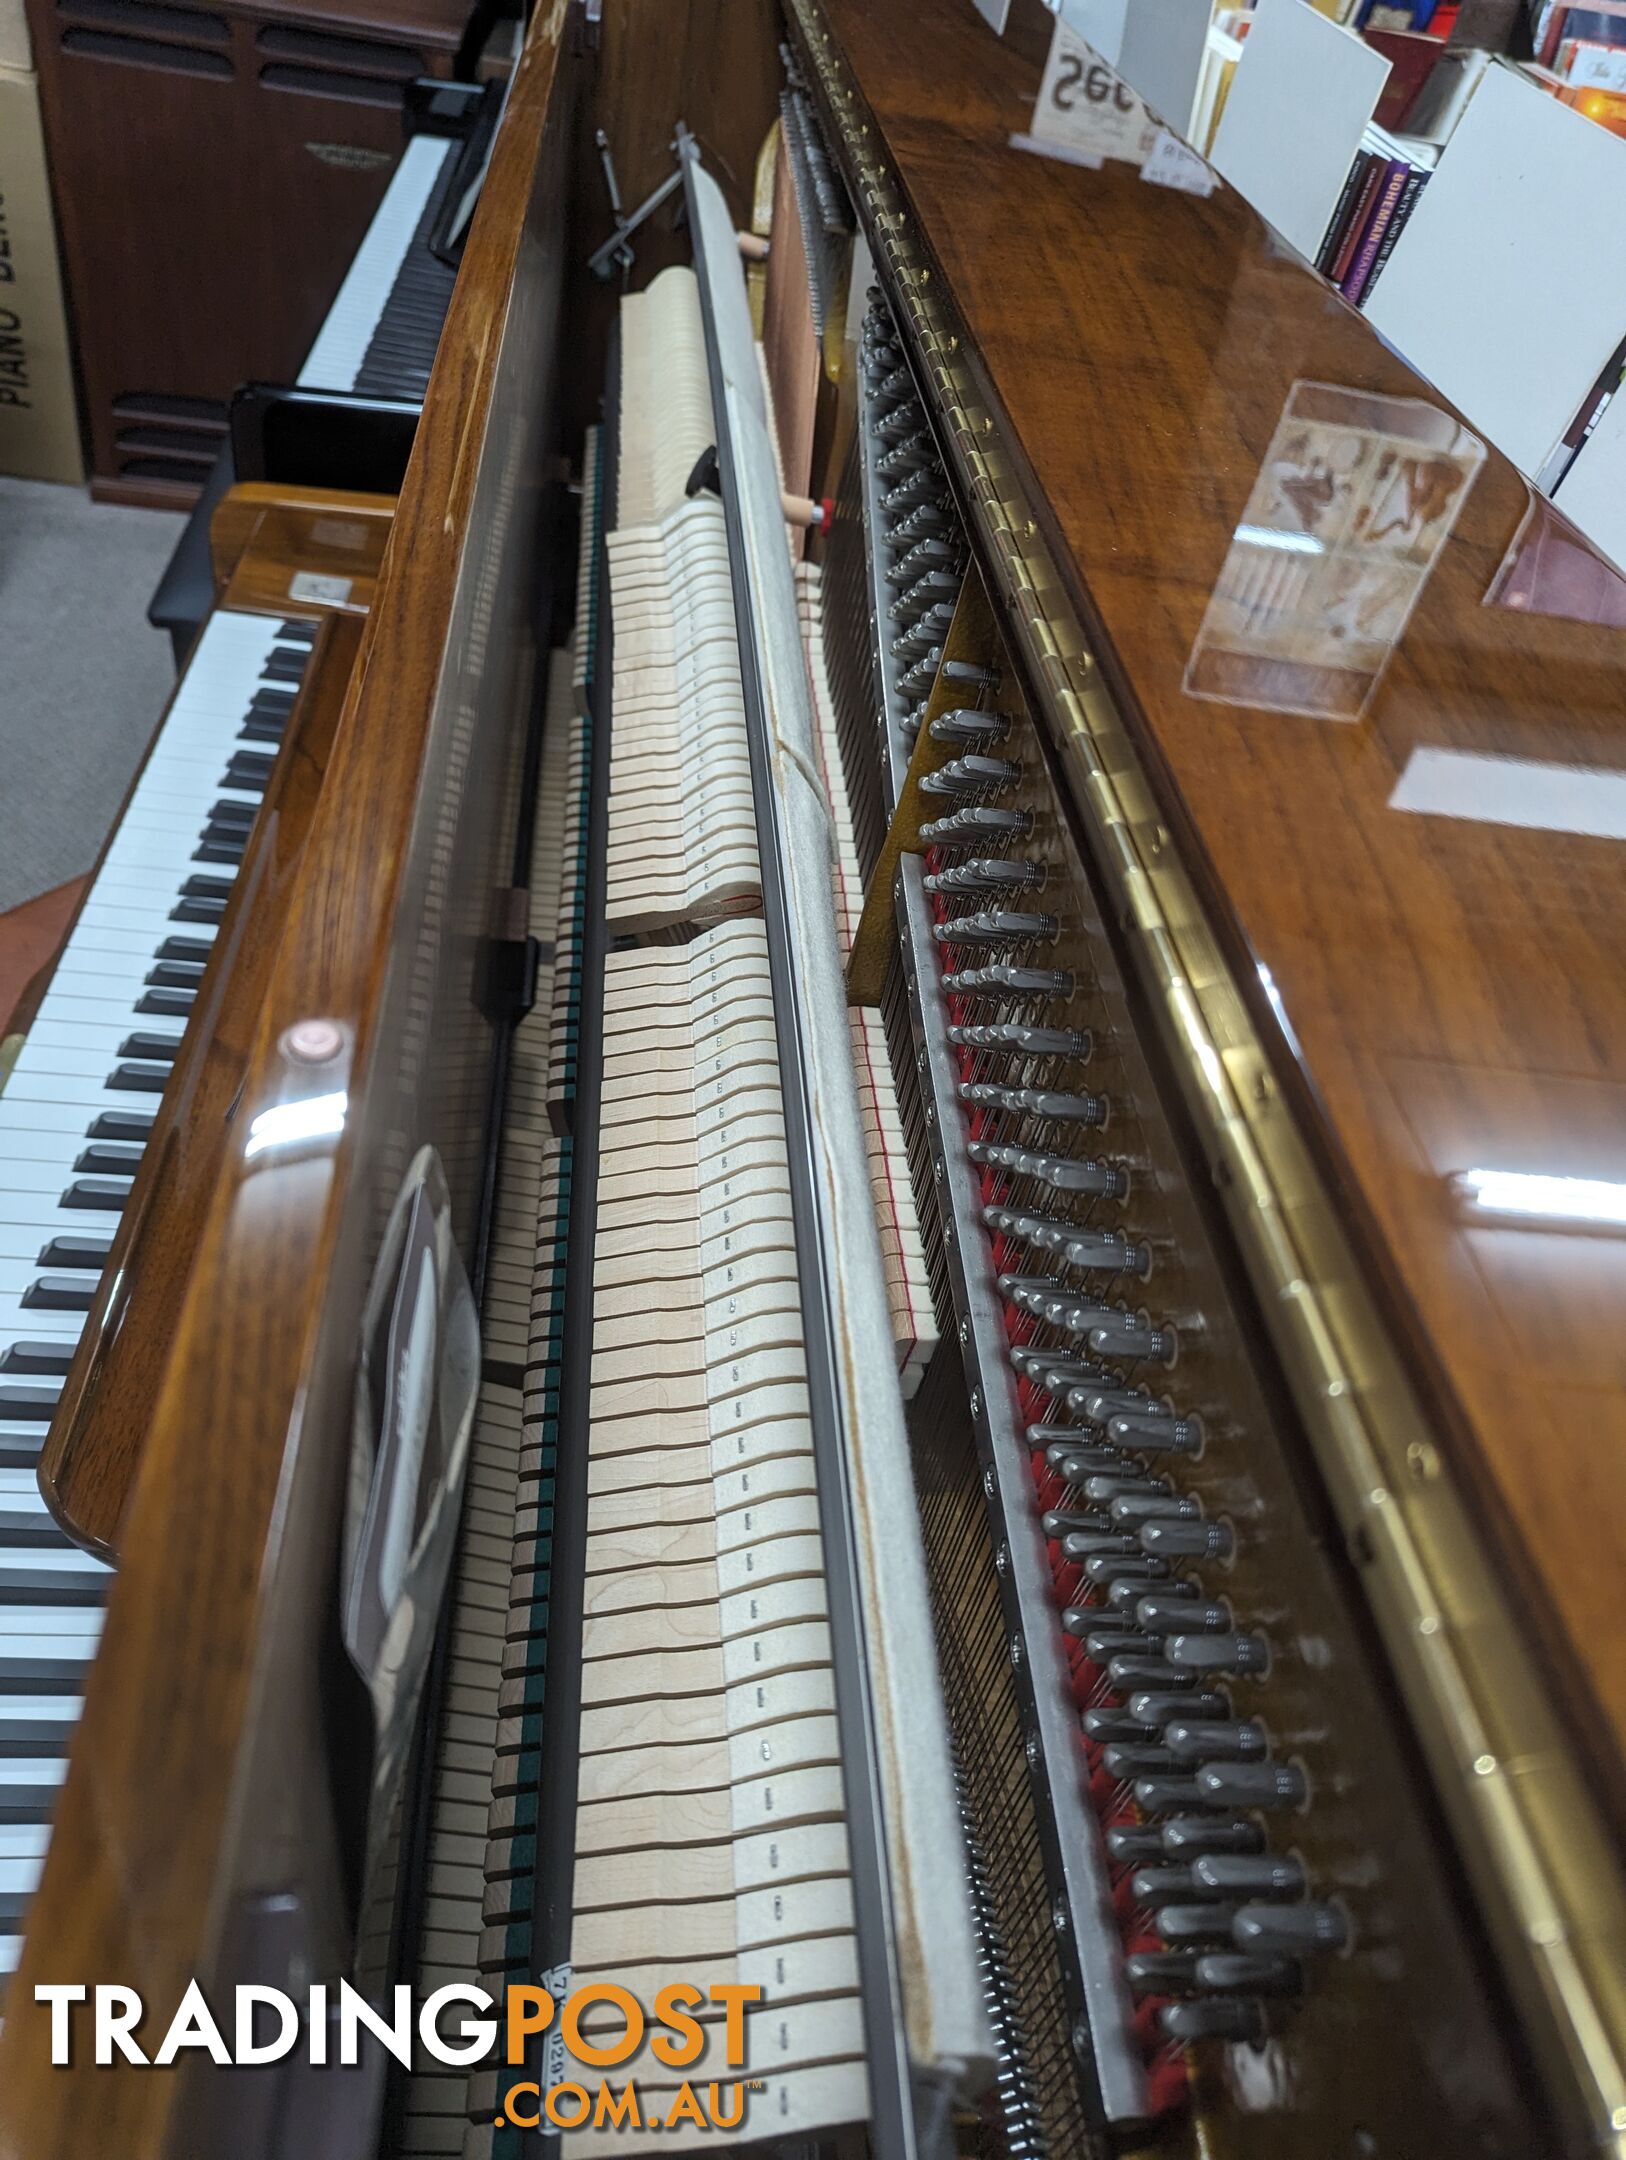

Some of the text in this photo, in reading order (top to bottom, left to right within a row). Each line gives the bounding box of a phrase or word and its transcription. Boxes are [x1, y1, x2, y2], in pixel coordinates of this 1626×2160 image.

[1369, 173, 1405, 243] BOHEMIAN
[1398, 178, 1421, 215] BEAUTY
[1387, 217, 1401, 239] AND
[1379, 239, 1394, 258] THE
[0, 308, 33, 409] PIANO
